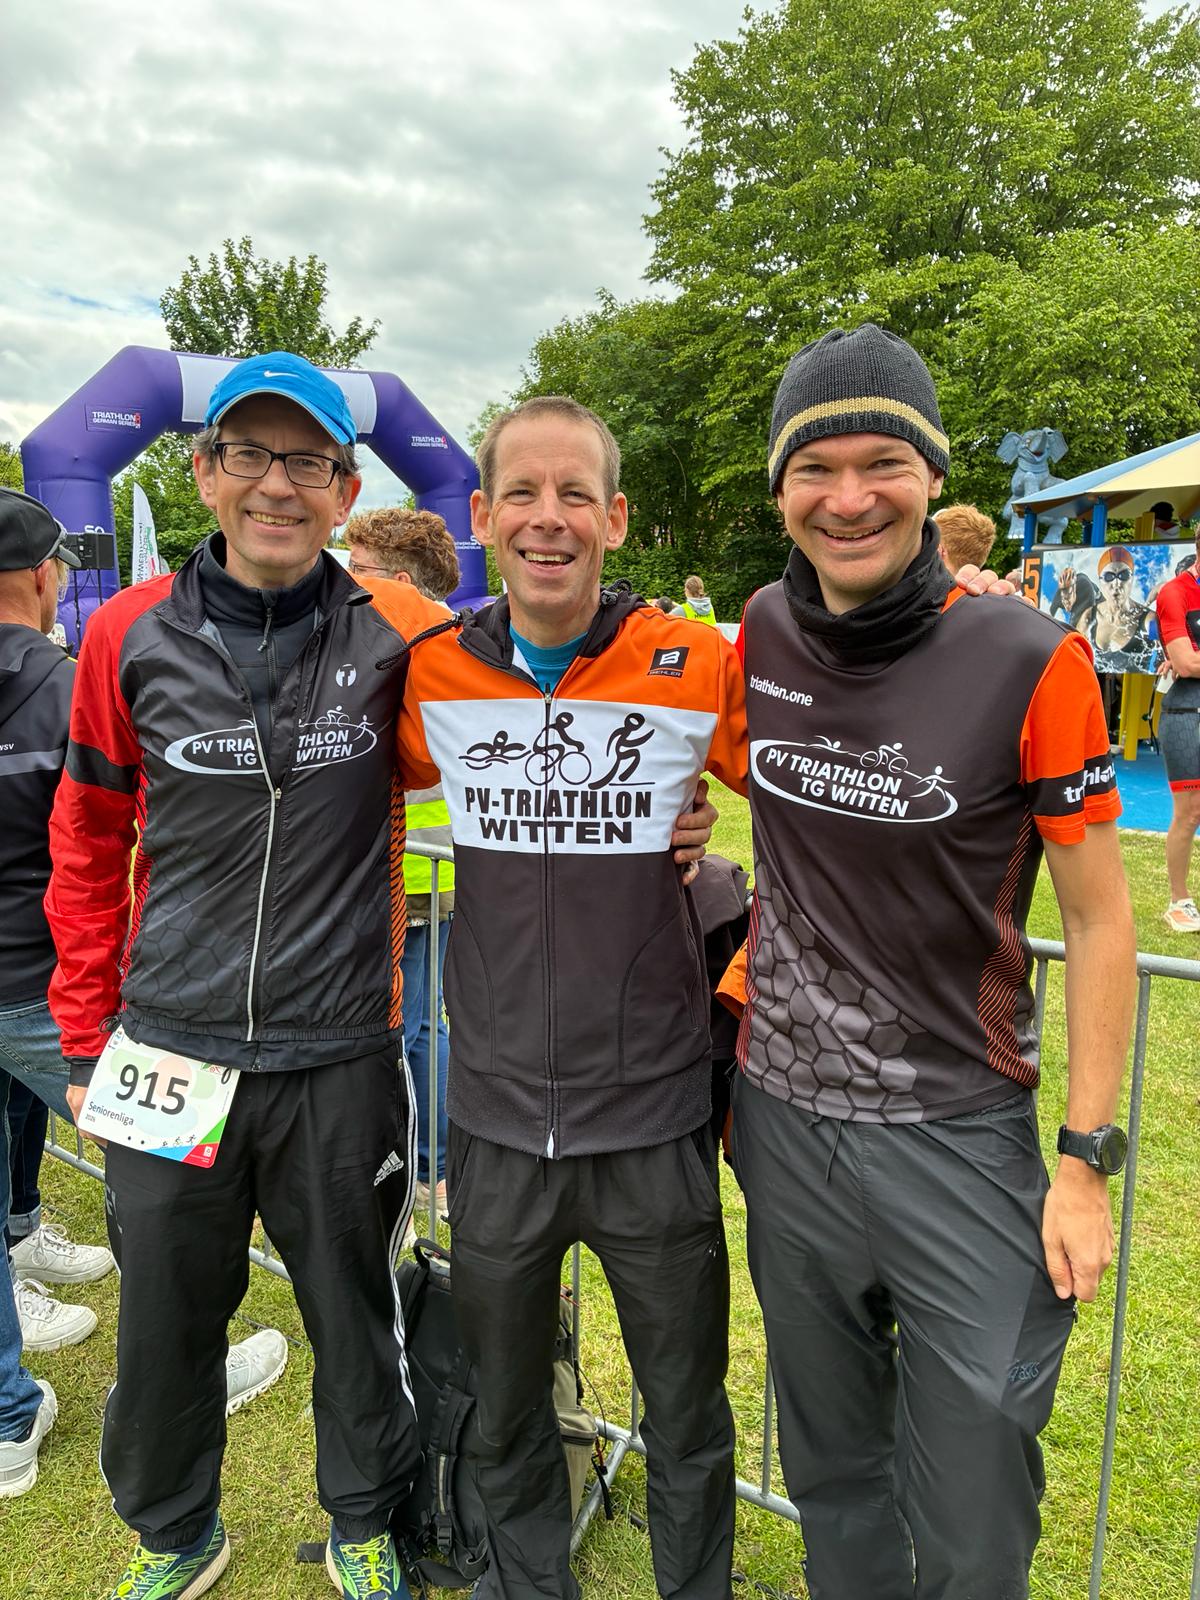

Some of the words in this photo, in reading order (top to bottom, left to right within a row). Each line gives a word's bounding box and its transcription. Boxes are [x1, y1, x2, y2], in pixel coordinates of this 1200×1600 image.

[92, 411, 135, 421] TRIATHLON
[750, 674, 813, 707] triathlon.one
[192, 741, 213, 755] PV
[234, 753, 258, 766] TG
[296, 744, 353, 763] WITTEN
[766, 747, 789, 768] PV
[789, 754, 902, 796] TRIATHLON
[465, 787, 651, 818] PV-TRIATHLON
[801, 777, 825, 798] TG
[830, 785, 910, 818] WITTEN
[479, 817, 632, 844] WITTEN
[115, 1063, 189, 1115] 915
[88, 1100, 134, 1126] Seniorenliga
[373, 1160, 404, 1187] adidas
